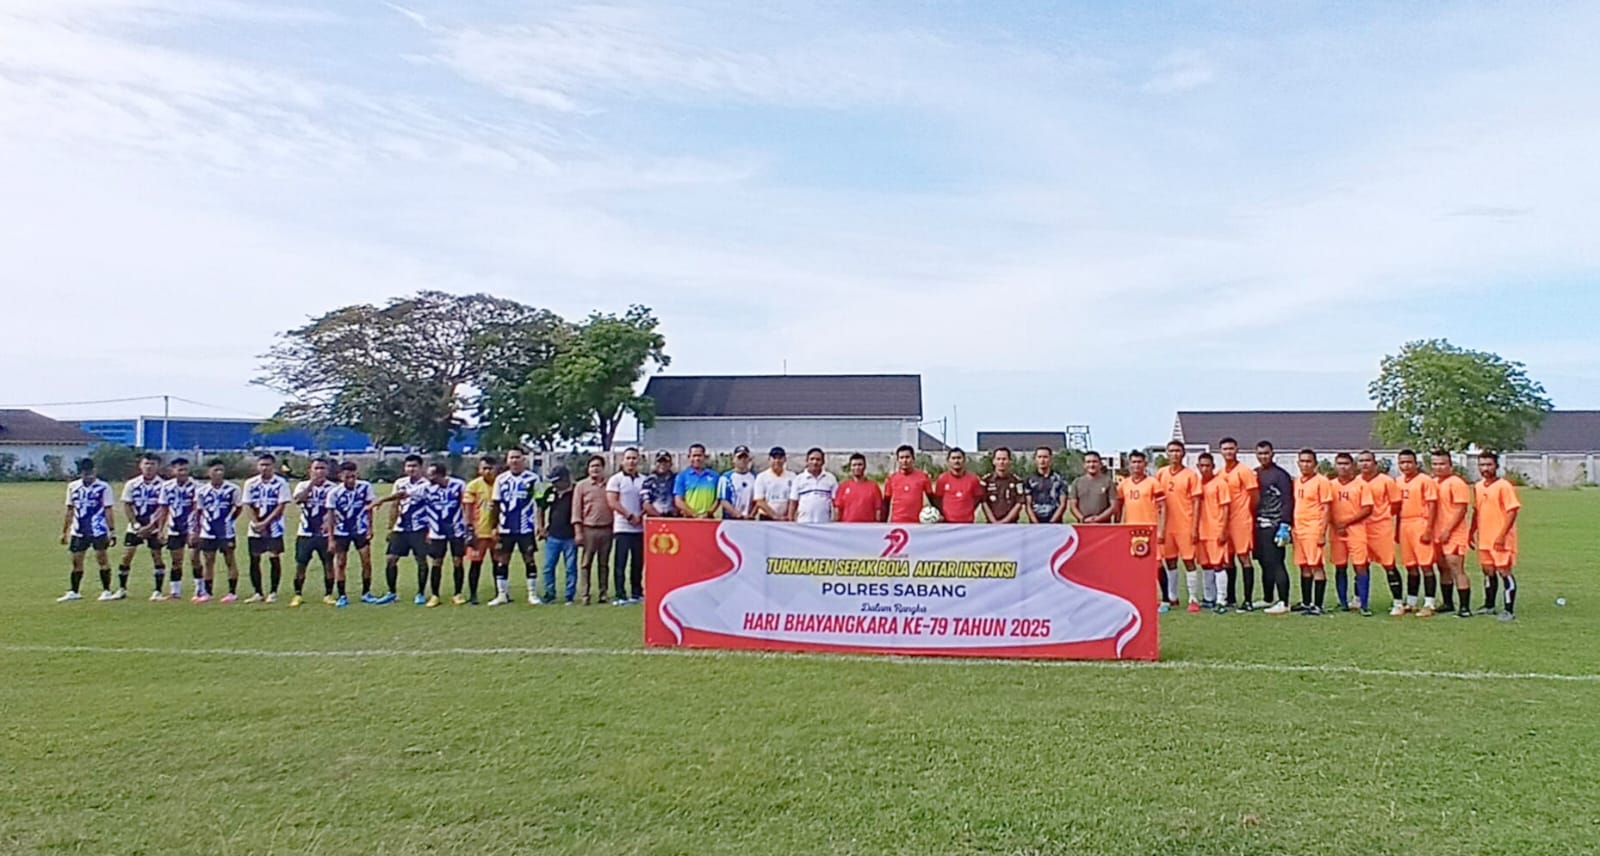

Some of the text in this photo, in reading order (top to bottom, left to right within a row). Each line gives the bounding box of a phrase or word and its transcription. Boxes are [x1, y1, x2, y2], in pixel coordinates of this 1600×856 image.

[1130, 489, 1140, 500] 10
[1338, 490, 1350, 501] 14
[767, 557, 1017, 579] TURNAMEN SEPAK BOLA ANTAR INSTANSI
[822, 582, 967, 598] POLRES SABANG
[860, 603, 927, 615] Dalam Rangka
[743, 612, 1051, 637] HARI BHAYANGKARA KE-79 TAHUN 2025
